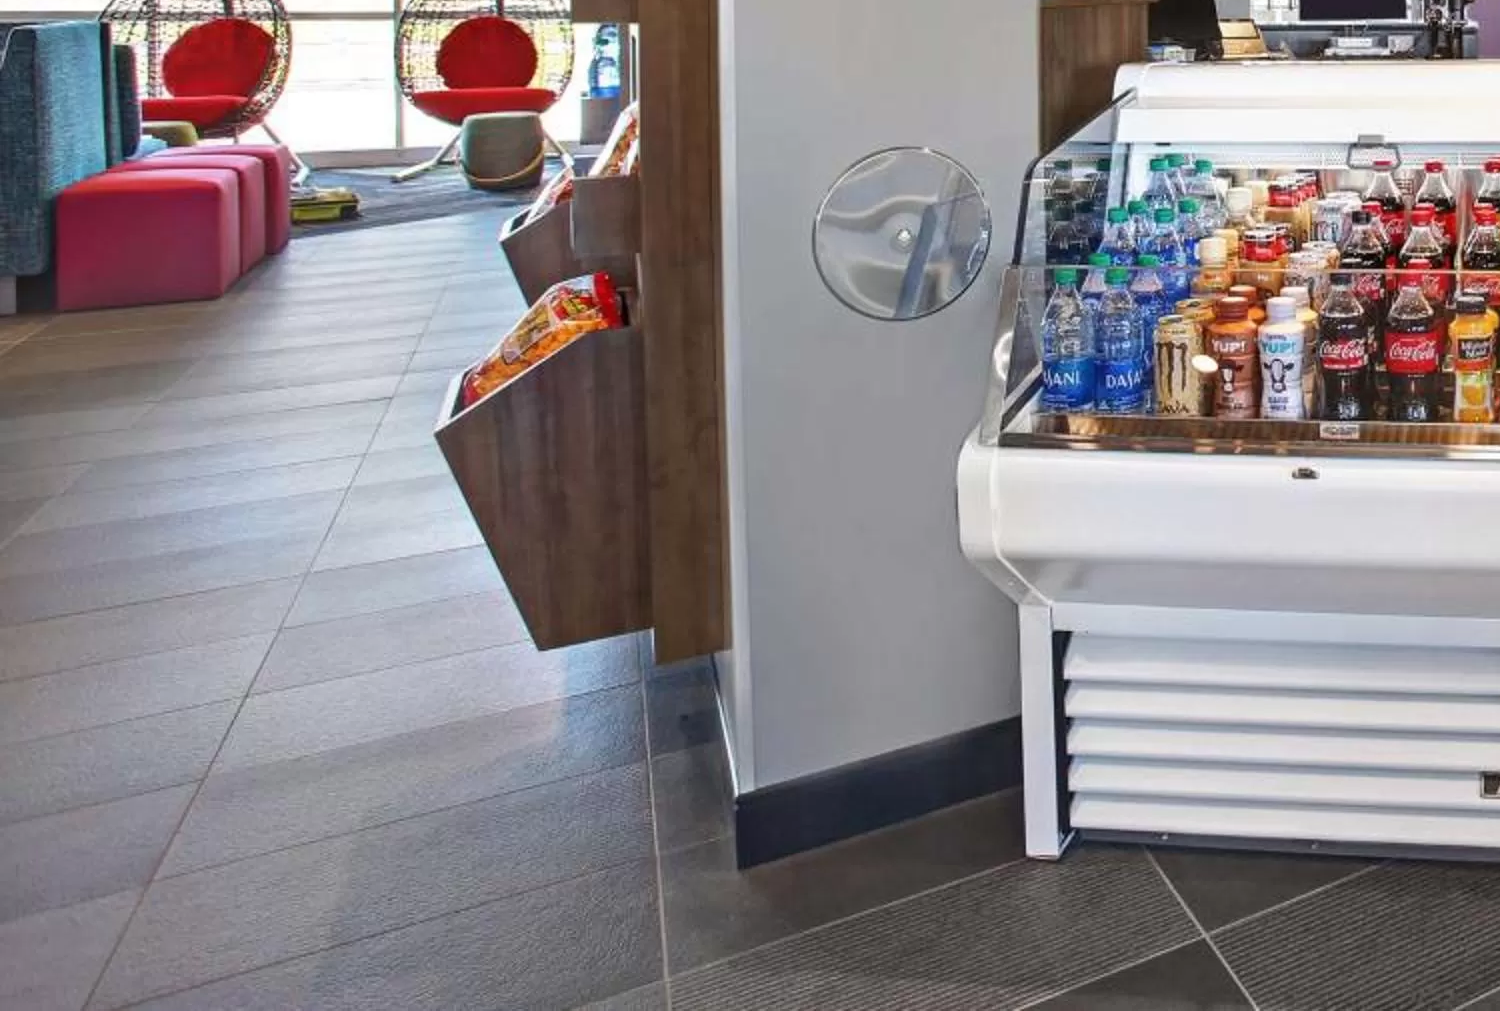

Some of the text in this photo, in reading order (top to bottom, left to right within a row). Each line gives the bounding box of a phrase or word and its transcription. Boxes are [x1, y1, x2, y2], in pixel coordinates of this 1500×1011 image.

[1211, 339, 1246, 353] YUP!
[1389, 339, 1437, 360] Coca-Cola
[1043, 368, 1081, 387] SANI
[1105, 368, 1143, 389] DASA
